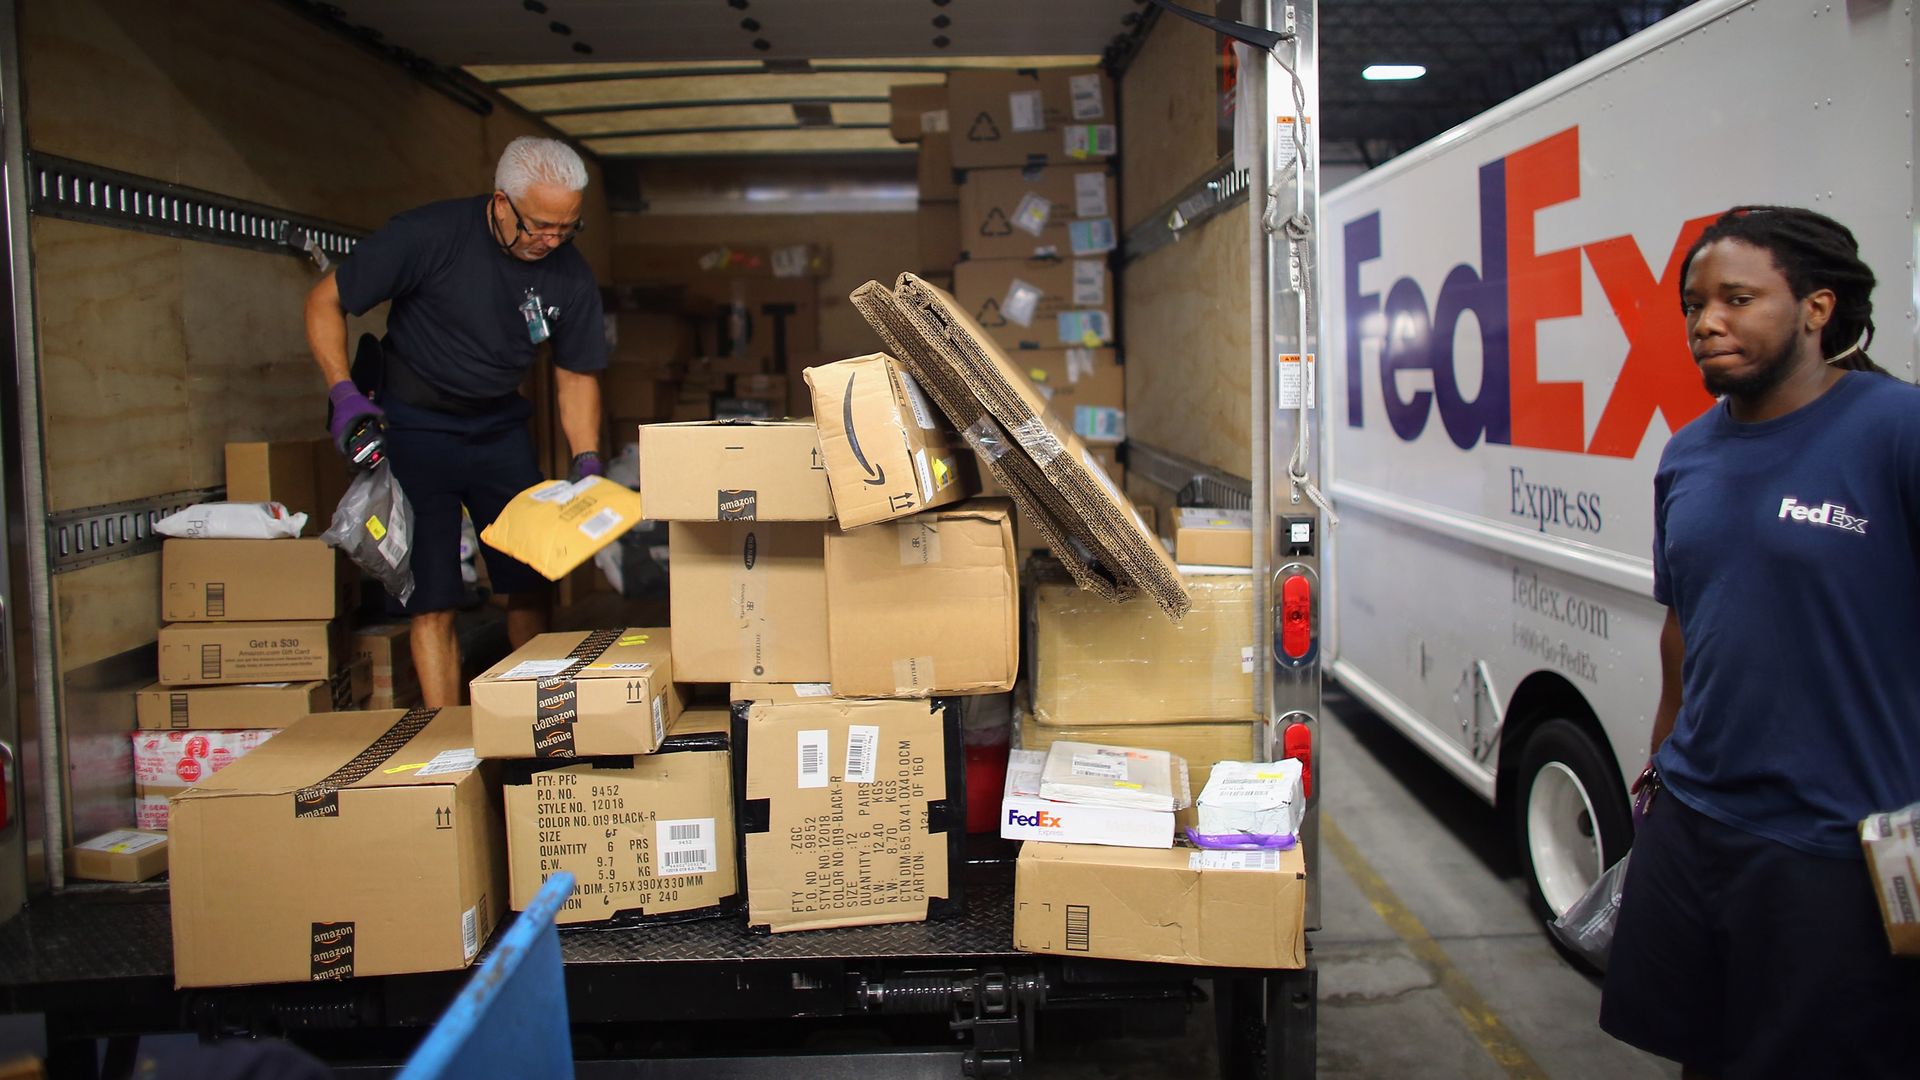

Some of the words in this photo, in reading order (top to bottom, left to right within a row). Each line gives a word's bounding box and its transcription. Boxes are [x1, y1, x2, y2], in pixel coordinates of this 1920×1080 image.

[1344, 124, 1736, 459] FedEx
[720, 496, 755, 510] amazon
[1510, 465, 1602, 534] Express
[1778, 498, 1868, 534] FedEx
[1511, 565, 1608, 640] fedex.com
[249, 640, 268, 648] Get
[280, 638, 299, 648] $30
[538, 690, 576, 708] amazon
[536, 731, 572, 750] amazon
[912, 757, 924, 776] 160
[536, 776, 556, 786] FTY:
[558, 774, 577, 786] PFC
[537, 789, 556, 800] P.O.
[558, 788, 576, 800] NO.
[592, 784, 619, 796] 9452
[858, 783, 870, 816] PAIRS
[872, 780, 883, 803] KGS
[885, 780, 897, 802] KGS
[912, 784, 924, 797] OF
[538, 802, 566, 814] STYLE
[569, 802, 586, 813] NO.
[592, 798, 624, 811] 12018
[538, 816, 571, 828] COLOR
[574, 816, 590, 826] NO.
[593, 814, 609, 826] 019
[612, 811, 656, 824] BLACK-R
[1008, 809, 1061, 828] FedEx
[539, 831, 561, 842] SIZE
[873, 824, 884, 853] 12.40
[886, 828, 898, 854] 8.70
[540, 844, 587, 856] QUANTITY
[608, 842, 614, 852] 6
[630, 839, 648, 850] PRS
[540, 860, 562, 870] G.W.
[597, 857, 614, 867] 9.7
[636, 853, 649, 864] KG
[598, 870, 616, 880] 5.9
[638, 866, 650, 877] KG
[913, 852, 924, 901] CARTON:
[584, 883, 606, 895] DIM.
[608, 877, 684, 893] 575X390X330
[686, 876, 704, 887] MM
[820, 874, 831, 910] STYLE
[832, 871, 844, 908] COLOR
[846, 881, 858, 908] SIZE
[873, 880, 885, 904] G.W:
[886, 878, 898, 903] N.W:
[900, 880, 912, 902] CTN
[640, 894, 652, 904] OF
[659, 891, 678, 902] 240
[792, 891, 804, 912] FTY
[314, 926, 353, 942] amazon
[313, 946, 352, 962] amazon
[312, 964, 352, 980] amazon
